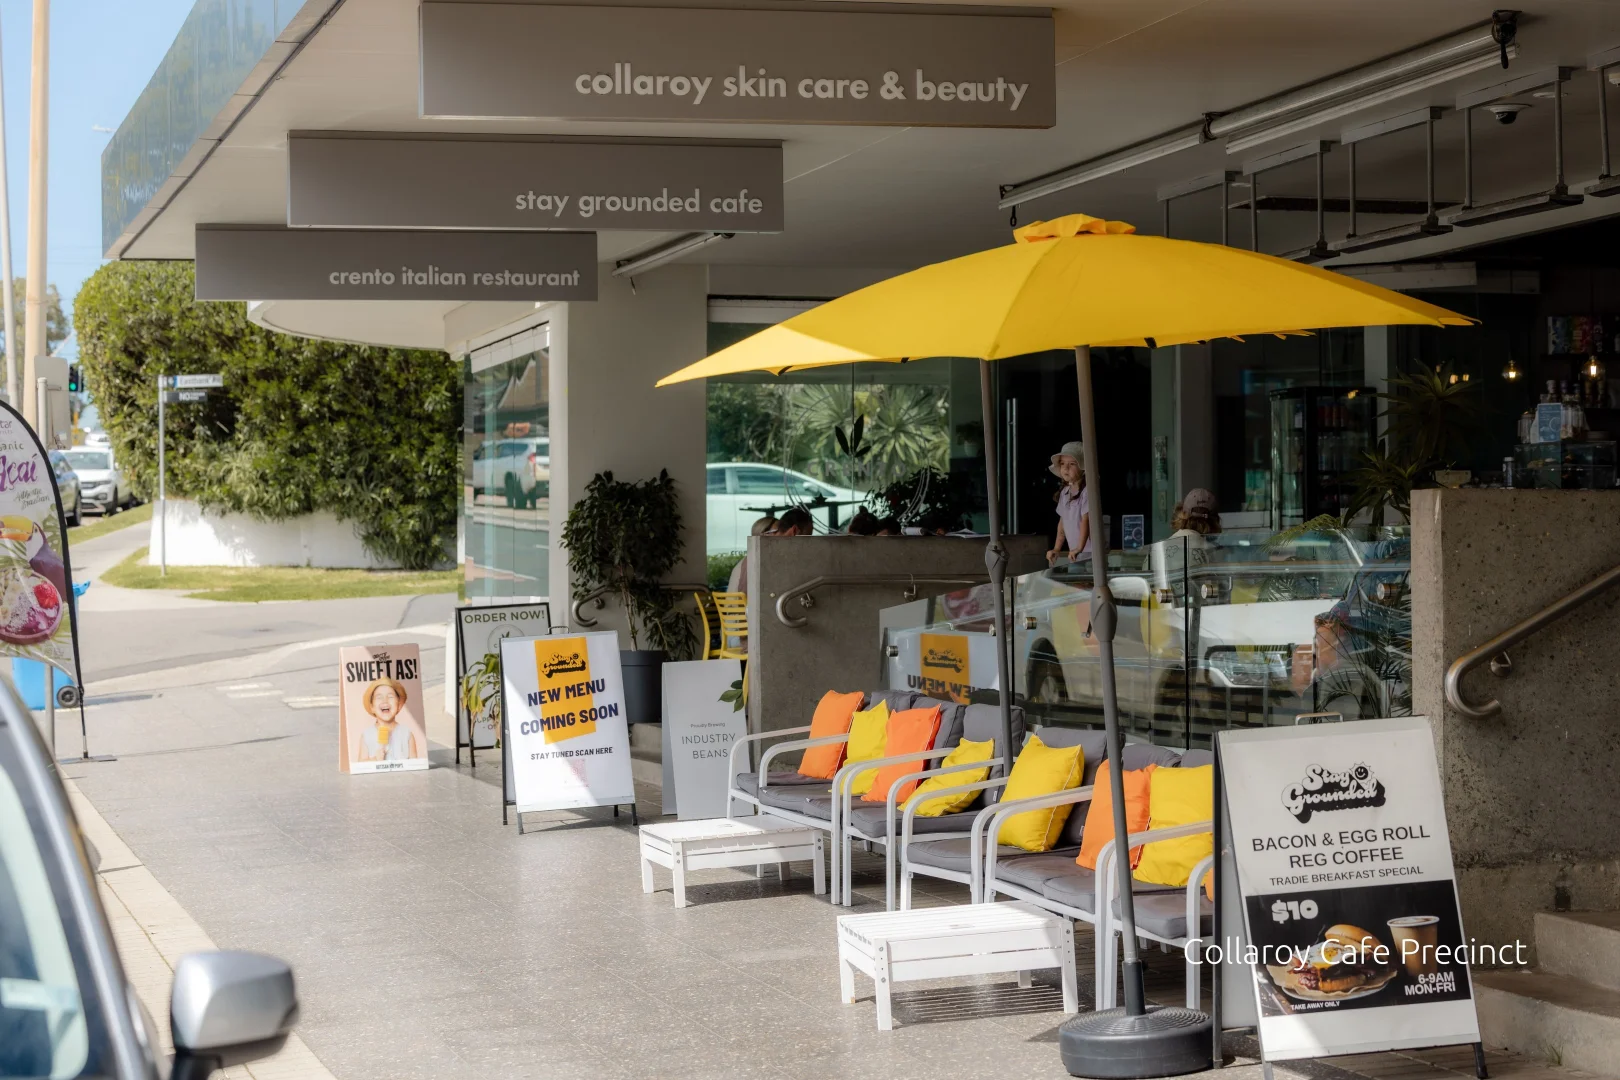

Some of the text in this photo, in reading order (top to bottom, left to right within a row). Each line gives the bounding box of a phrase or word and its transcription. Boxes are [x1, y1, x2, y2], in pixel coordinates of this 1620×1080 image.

[574, 62, 1029, 111] collaroy skin care & beauty
[515, 188, 763, 218] stay grounded cafe
[329, 265, 580, 287] crento italian restaurant
[464, 610, 545, 624] ORDER NOW!
[346, 658, 418, 683] SWEET AS!
[527, 678, 606, 707] NEW MENU
[520, 703, 619, 736] COMING SOON
[681, 733, 736, 745] INDUSTRY
[530, 746, 613, 761] STAY TUNED SCAN HERE
[692, 748, 728, 759] BEANS
[1302, 763, 1350, 791] Stay
[1281, 778, 1381, 817] Grounded
[1252, 824, 1431, 852] BACON & EGG ROLL
[1289, 846, 1404, 868] REG COFFEE
[1269, 865, 1424, 887] TRADIE BREAKFAST SPECIAL
[1271, 899, 1318, 924] $10
[1417, 971, 1455, 985] 6-9AM
[1404, 983, 1456, 997] MON-FRI
[1291, 1000, 1341, 1011] TAKE AWAY ONLY
